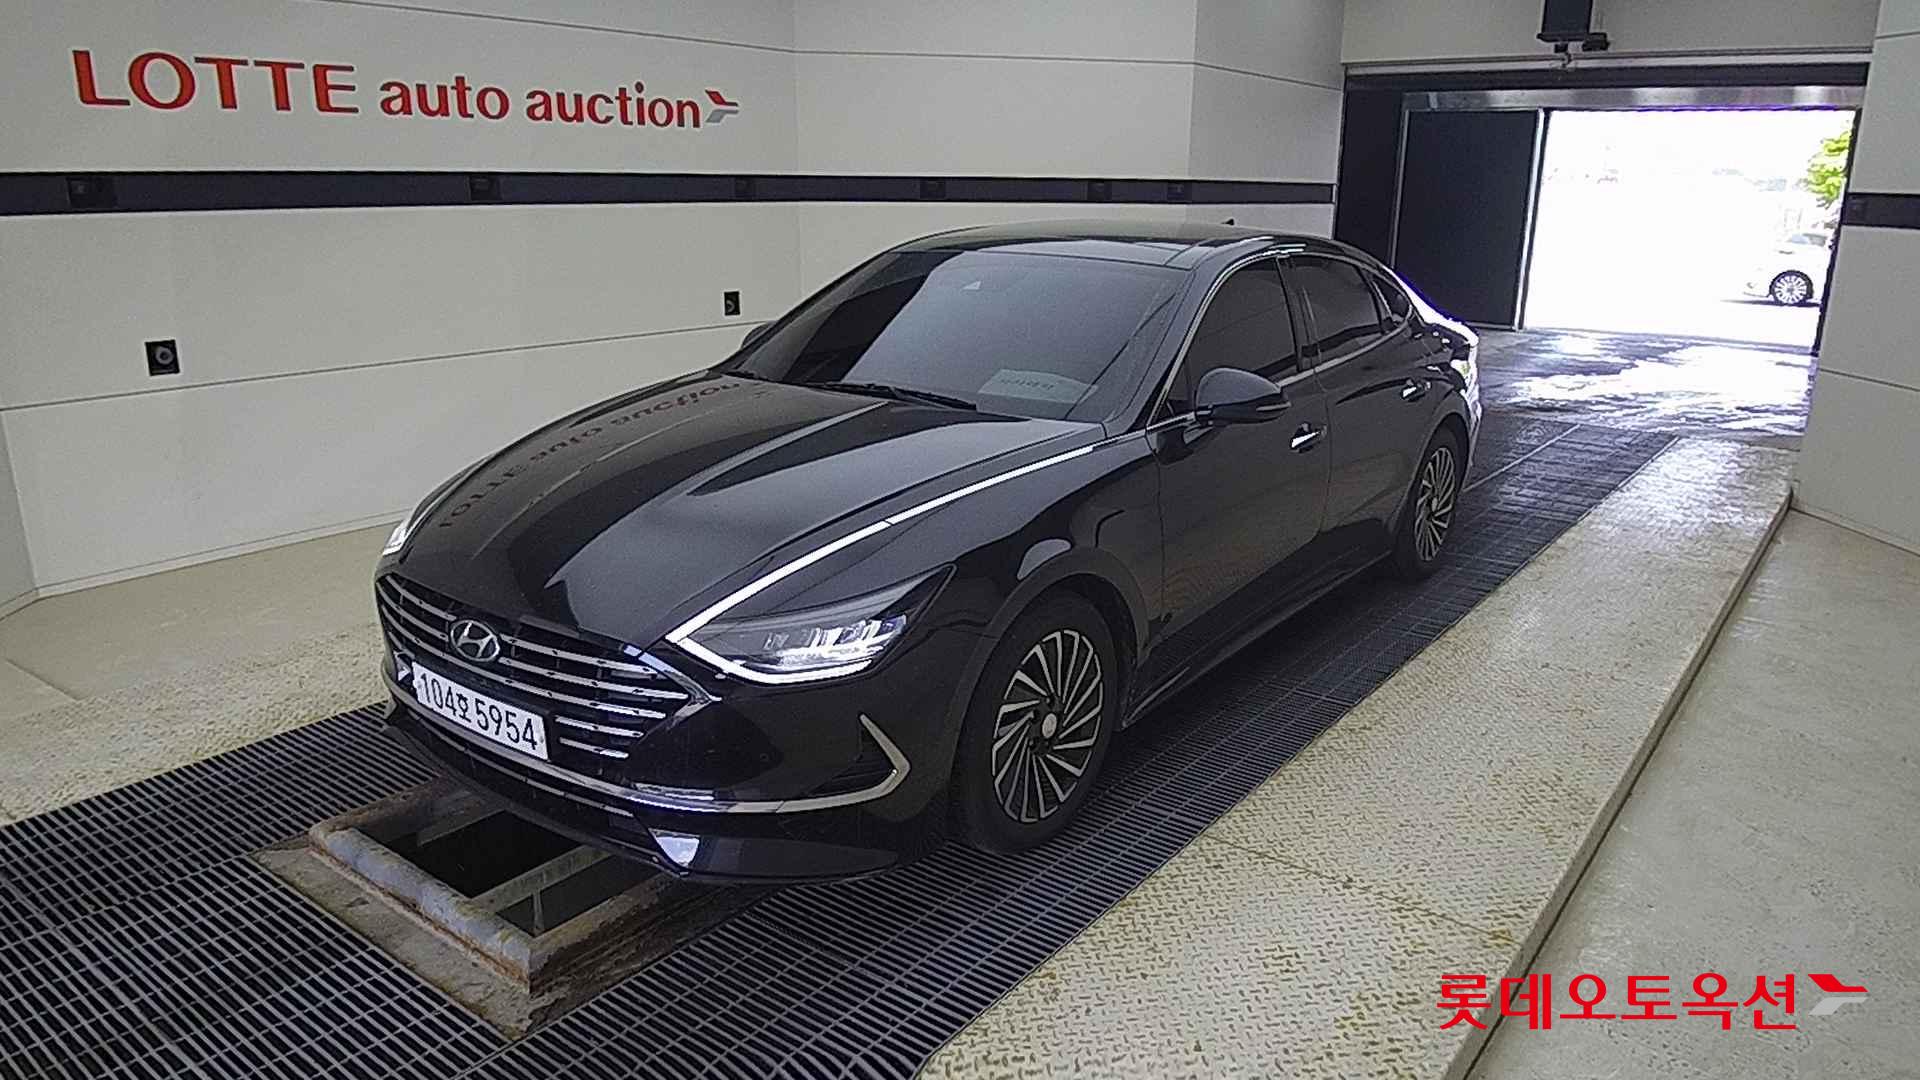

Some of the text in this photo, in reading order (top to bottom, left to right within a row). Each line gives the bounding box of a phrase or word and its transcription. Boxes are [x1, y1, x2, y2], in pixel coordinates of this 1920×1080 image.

[72, 49, 701, 129] LOTTE auto auction
[419, 672, 537, 751] 104호 5954
